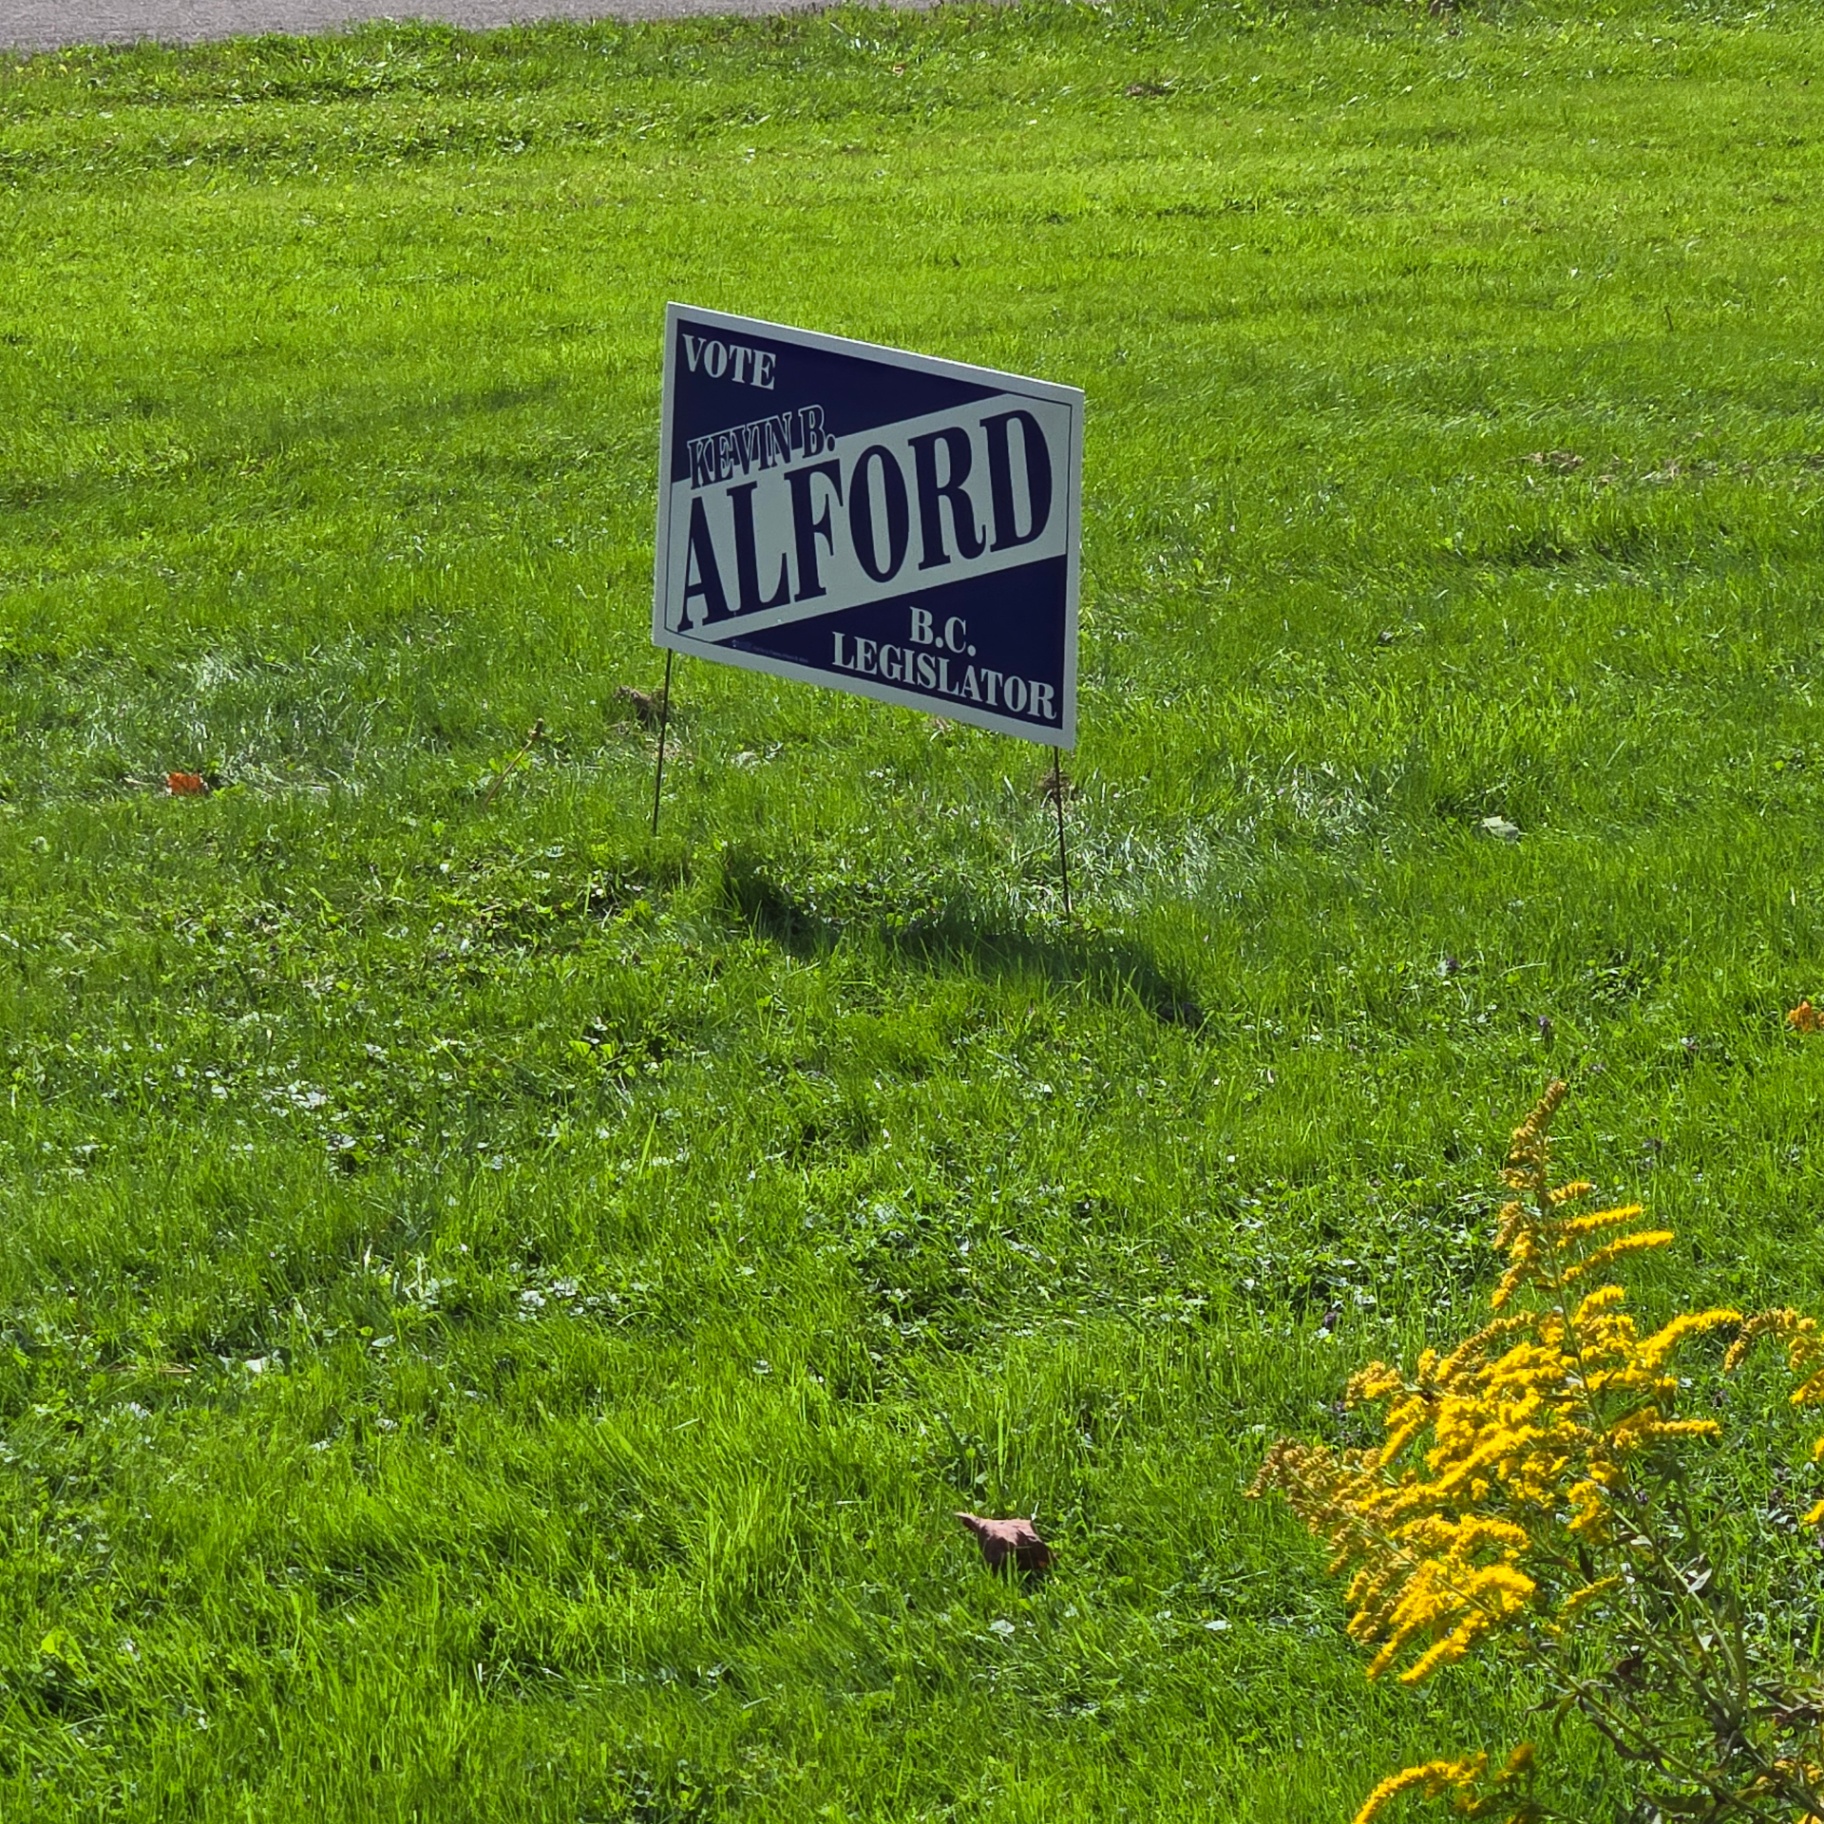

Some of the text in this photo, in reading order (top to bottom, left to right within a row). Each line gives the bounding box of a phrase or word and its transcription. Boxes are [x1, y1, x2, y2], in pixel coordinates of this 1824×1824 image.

[682, 333, 776, 390] VOTE
[687, 404, 836, 490] KEVIN B.
[677, 409, 1053, 633] ALFORD
[909, 606, 977, 657] B.C.
[832, 631, 1057, 720] LEGISLATOR
